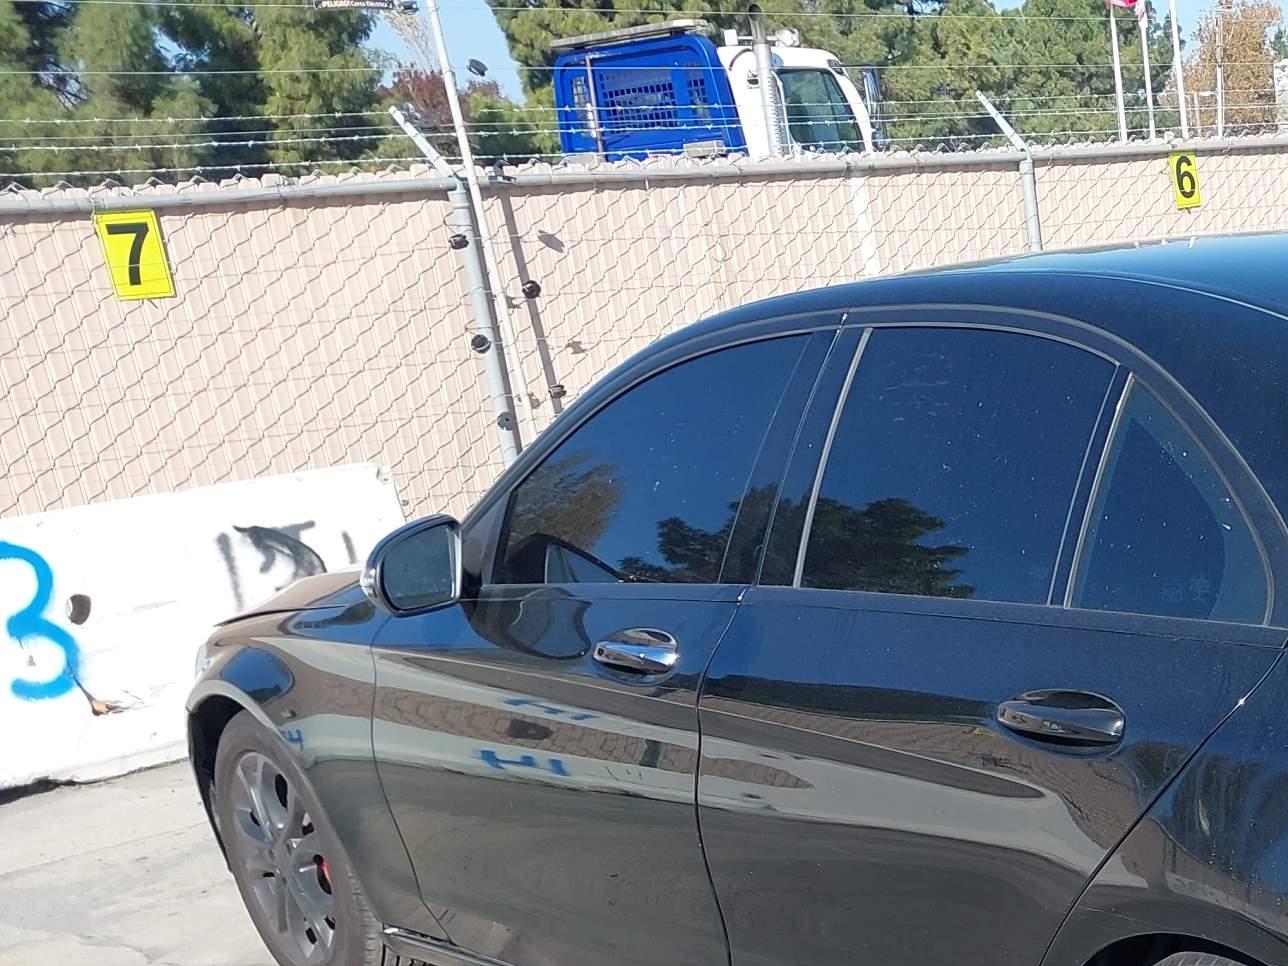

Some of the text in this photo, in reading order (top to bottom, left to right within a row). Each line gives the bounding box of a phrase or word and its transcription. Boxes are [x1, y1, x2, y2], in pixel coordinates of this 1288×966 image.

[1175, 155, 1196, 199] 6
[104, 222, 150, 286] 7
[0, 540, 81, 701] 3
